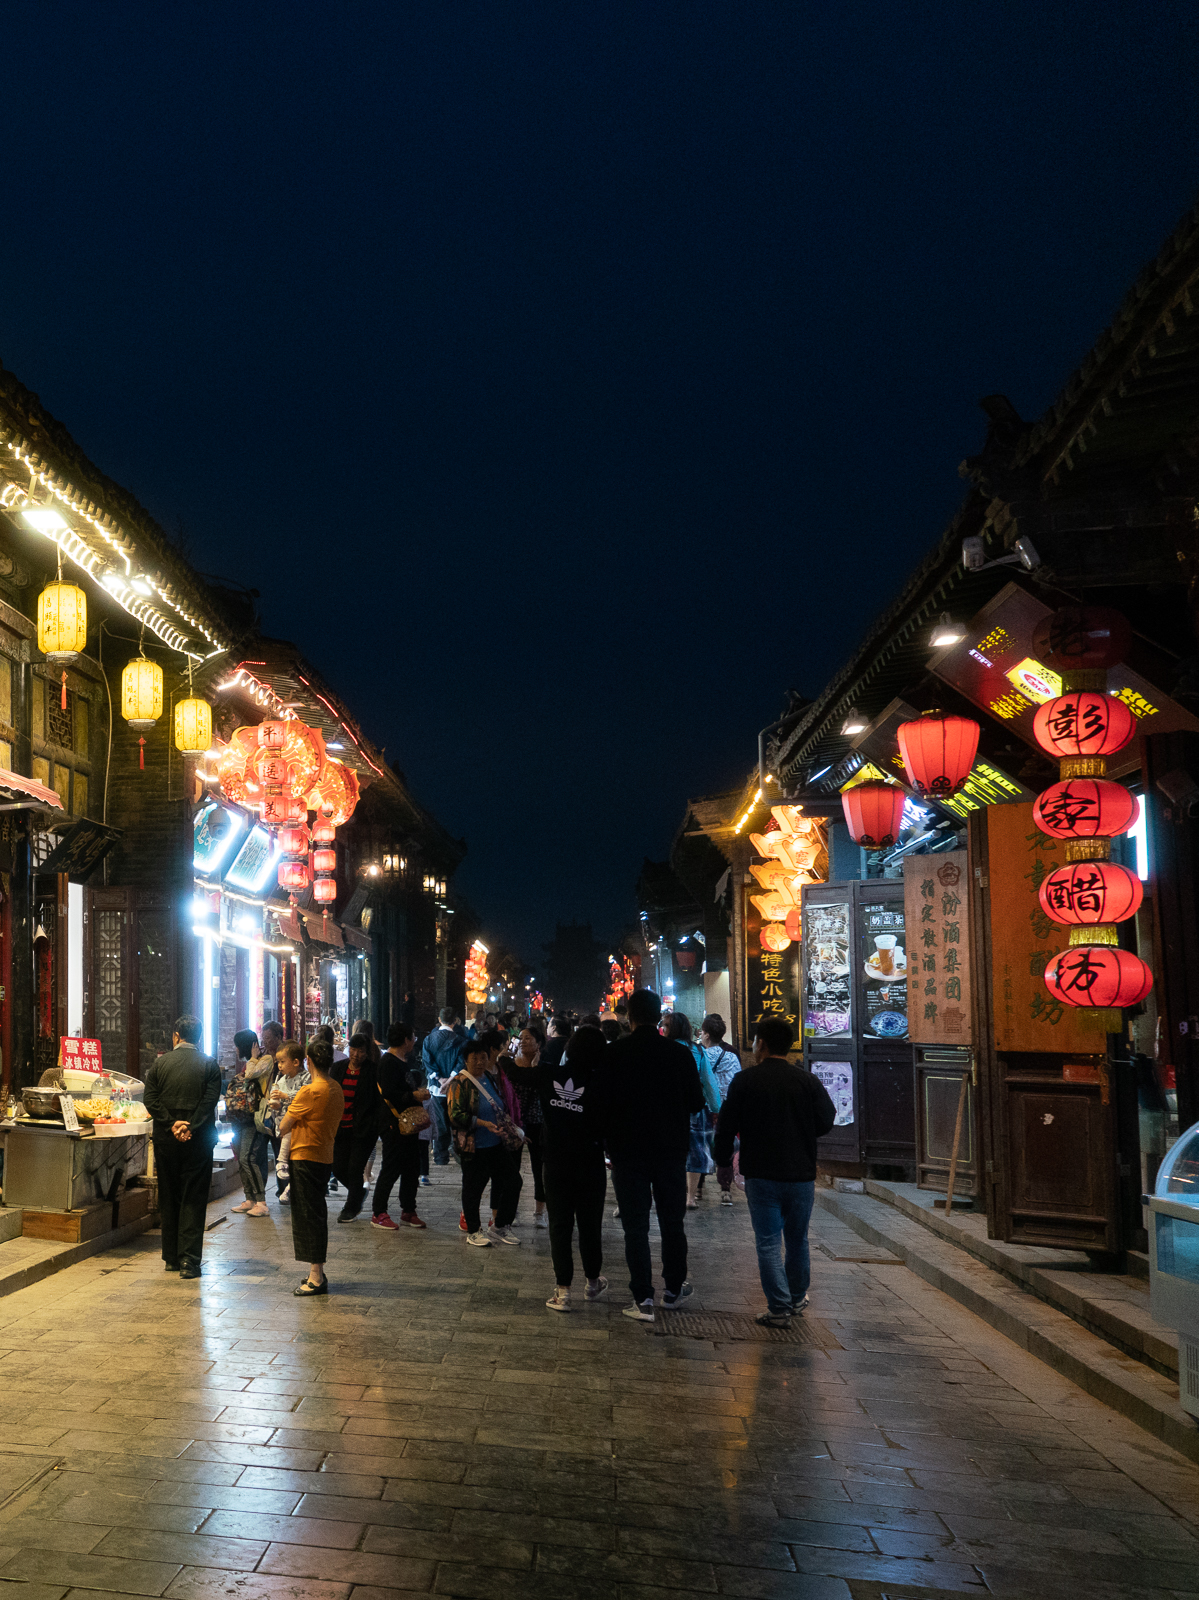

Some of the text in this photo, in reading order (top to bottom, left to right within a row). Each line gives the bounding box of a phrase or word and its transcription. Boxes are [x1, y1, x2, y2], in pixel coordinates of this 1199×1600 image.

[941, 890, 962, 1003] 汾酒集团
[761, 952, 785, 1013] 特色小吃
[64, 1038, 98, 1056] 雪糕
[64, 1055, 100, 1072] 冰镇冷饮
[550, 1098, 584, 1113] adidas
